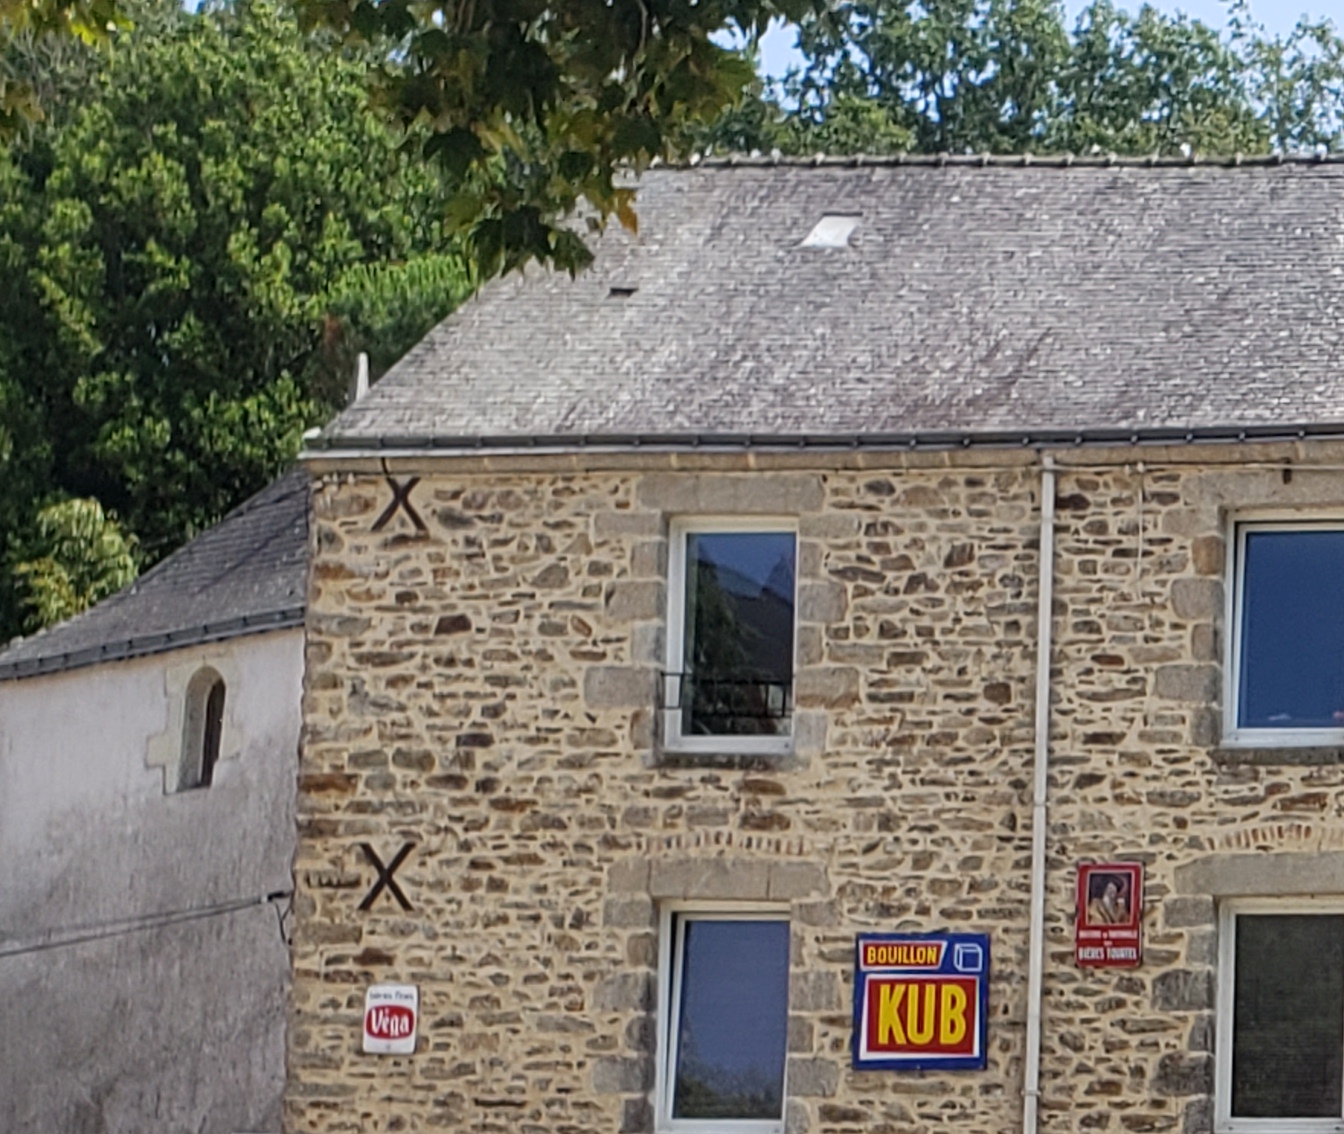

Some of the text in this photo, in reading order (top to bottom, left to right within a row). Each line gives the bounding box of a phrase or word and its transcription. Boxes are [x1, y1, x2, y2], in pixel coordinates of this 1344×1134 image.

[867, 945, 938, 965] BOUILLON
[371, 1006, 411, 1038] Véga
[878, 983, 967, 1046] KUB
